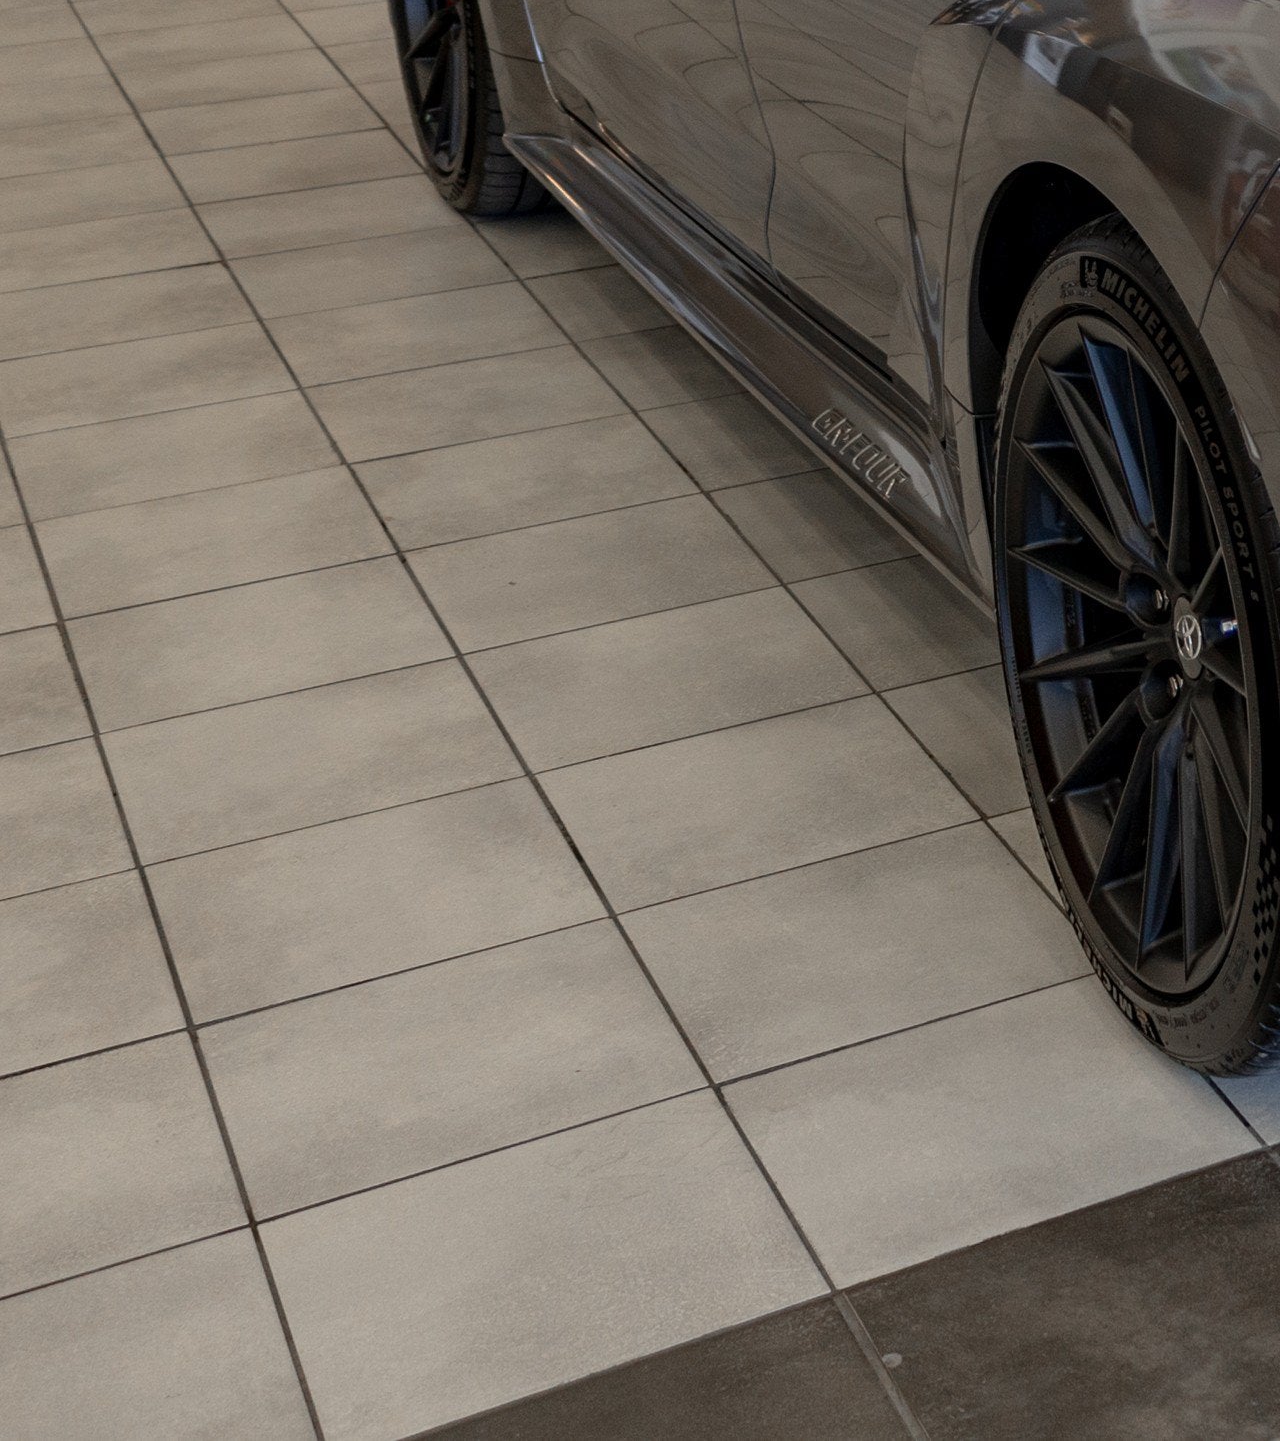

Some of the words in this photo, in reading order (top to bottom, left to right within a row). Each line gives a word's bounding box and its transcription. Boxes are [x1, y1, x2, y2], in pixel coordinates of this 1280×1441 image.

[1100, 269, 1190, 384] MICHELIN
[1195, 405, 1227, 475] PILOT
[1222, 486, 1255, 579] SPORT
